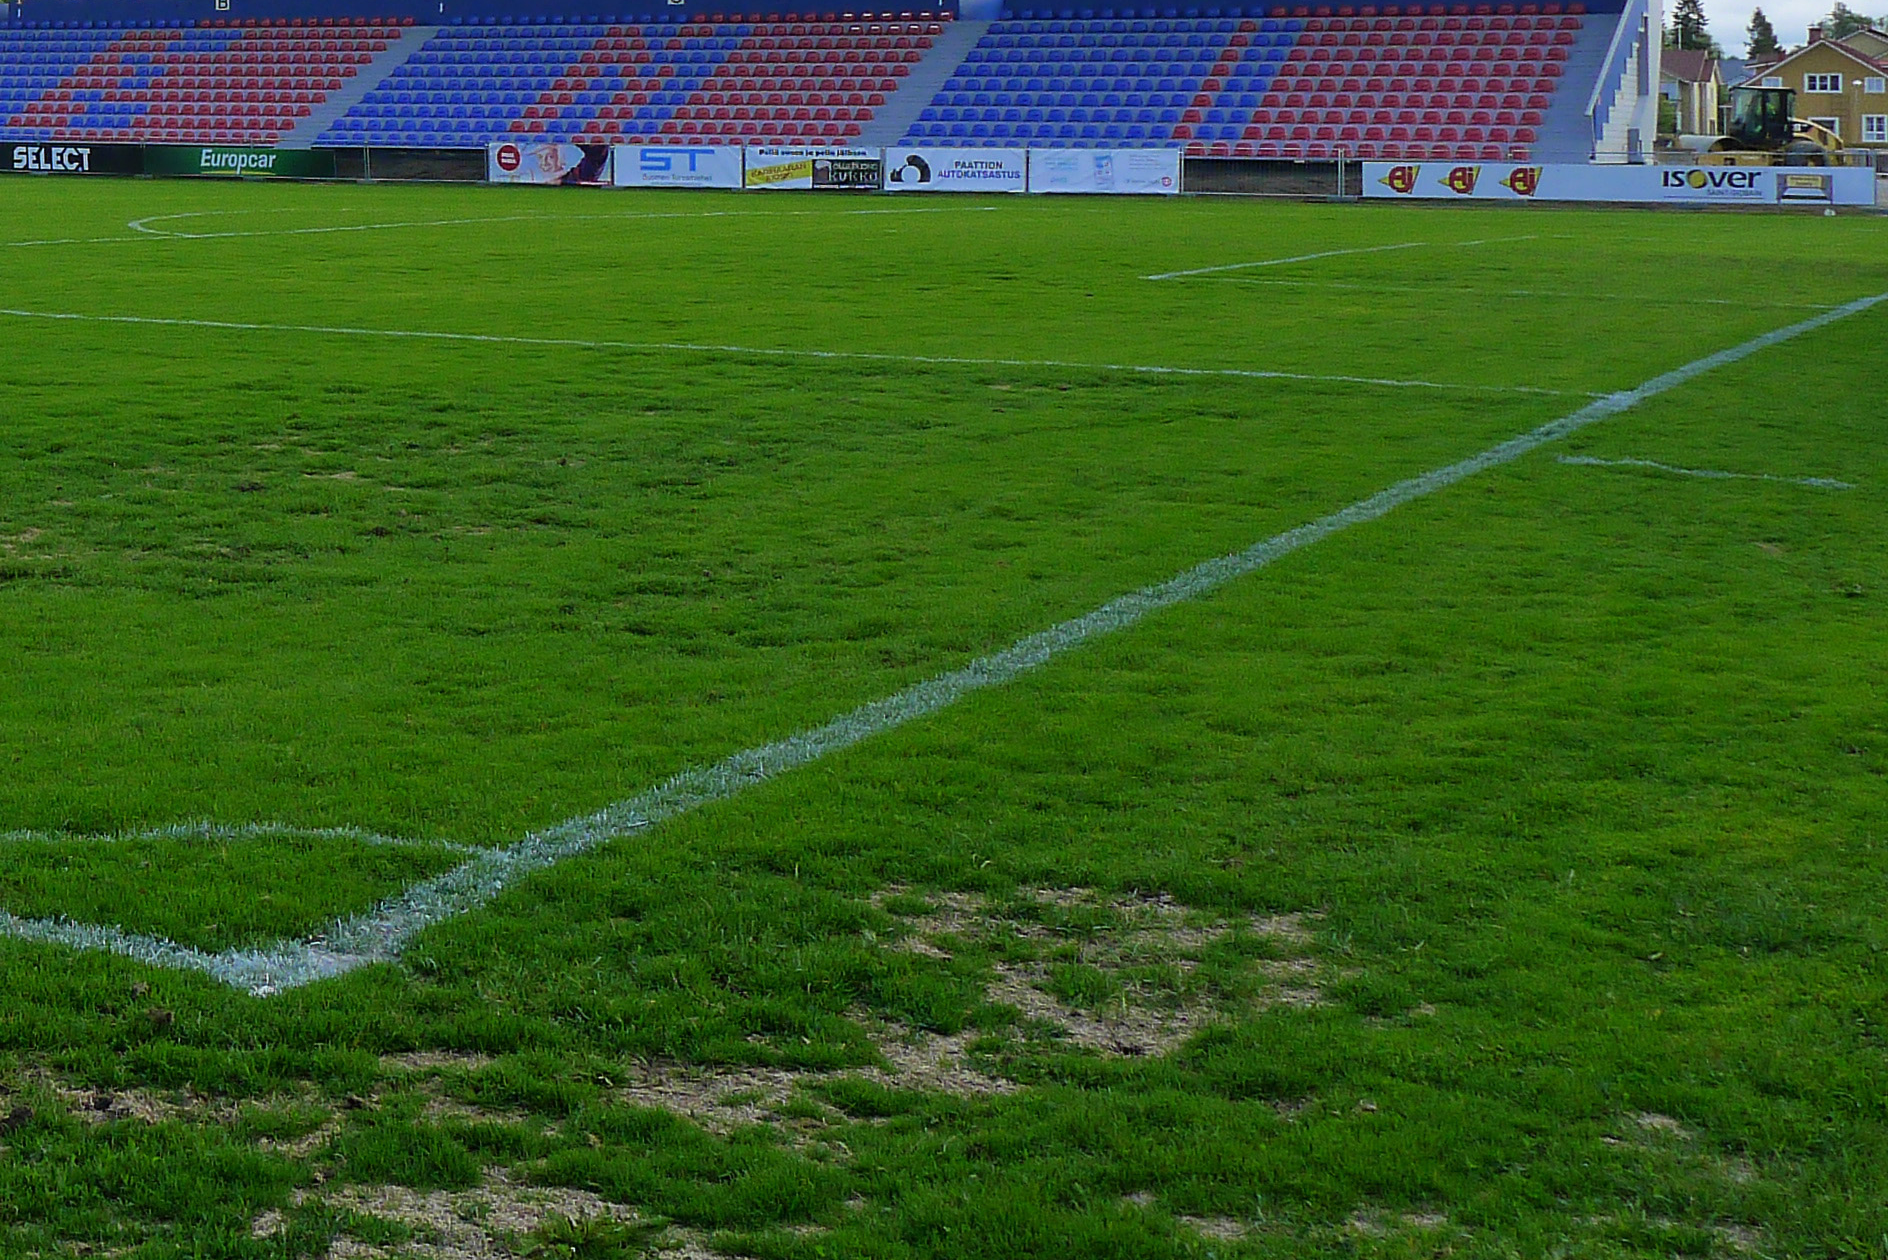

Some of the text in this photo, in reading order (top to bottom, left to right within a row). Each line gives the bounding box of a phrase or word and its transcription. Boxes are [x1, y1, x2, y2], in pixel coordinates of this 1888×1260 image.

[13, 146, 91, 171] SELECT
[200, 149, 277, 175] Europcar
[640, 148, 715, 171] ST
[954, 160, 1003, 170] PAATTION
[937, 170, 1021, 179] AUTOKATSASTUS
